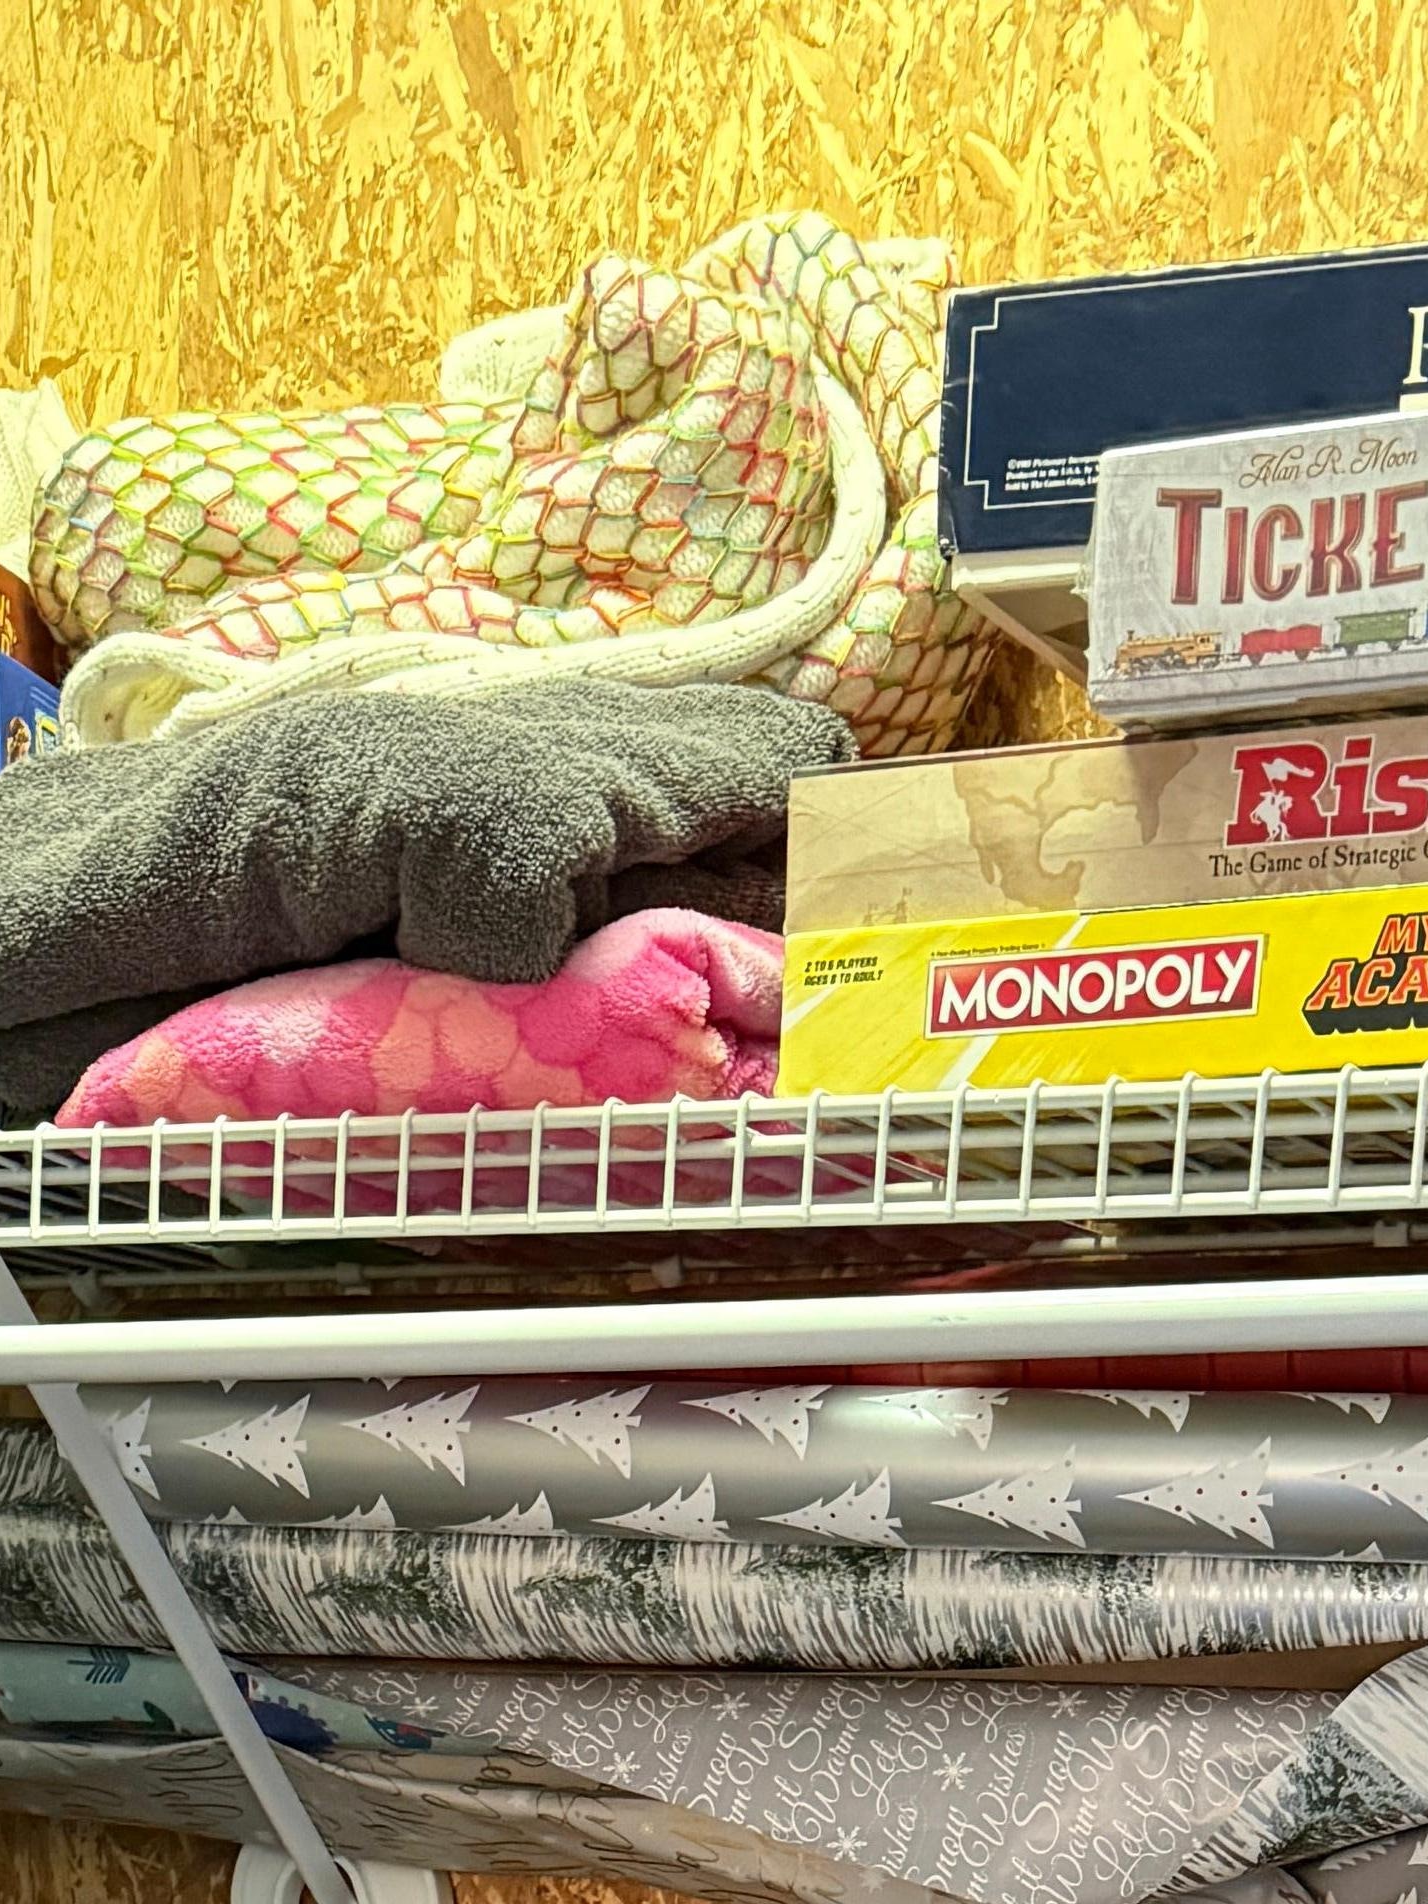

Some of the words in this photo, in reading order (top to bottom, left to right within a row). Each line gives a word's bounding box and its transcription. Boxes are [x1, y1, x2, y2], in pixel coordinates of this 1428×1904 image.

[1346, 437, 1419, 477] Moon
[1208, 853, 1244, 878] The
[1249, 851, 1302, 875] Game
[1308, 846, 1328, 869] of
[1332, 841, 1418, 870] Strategic
[836, 956, 879, 971] PLAYERS
[938, 948, 1254, 1024] MONOPOLY
[1012, 1728, 1081, 1854] Snow
